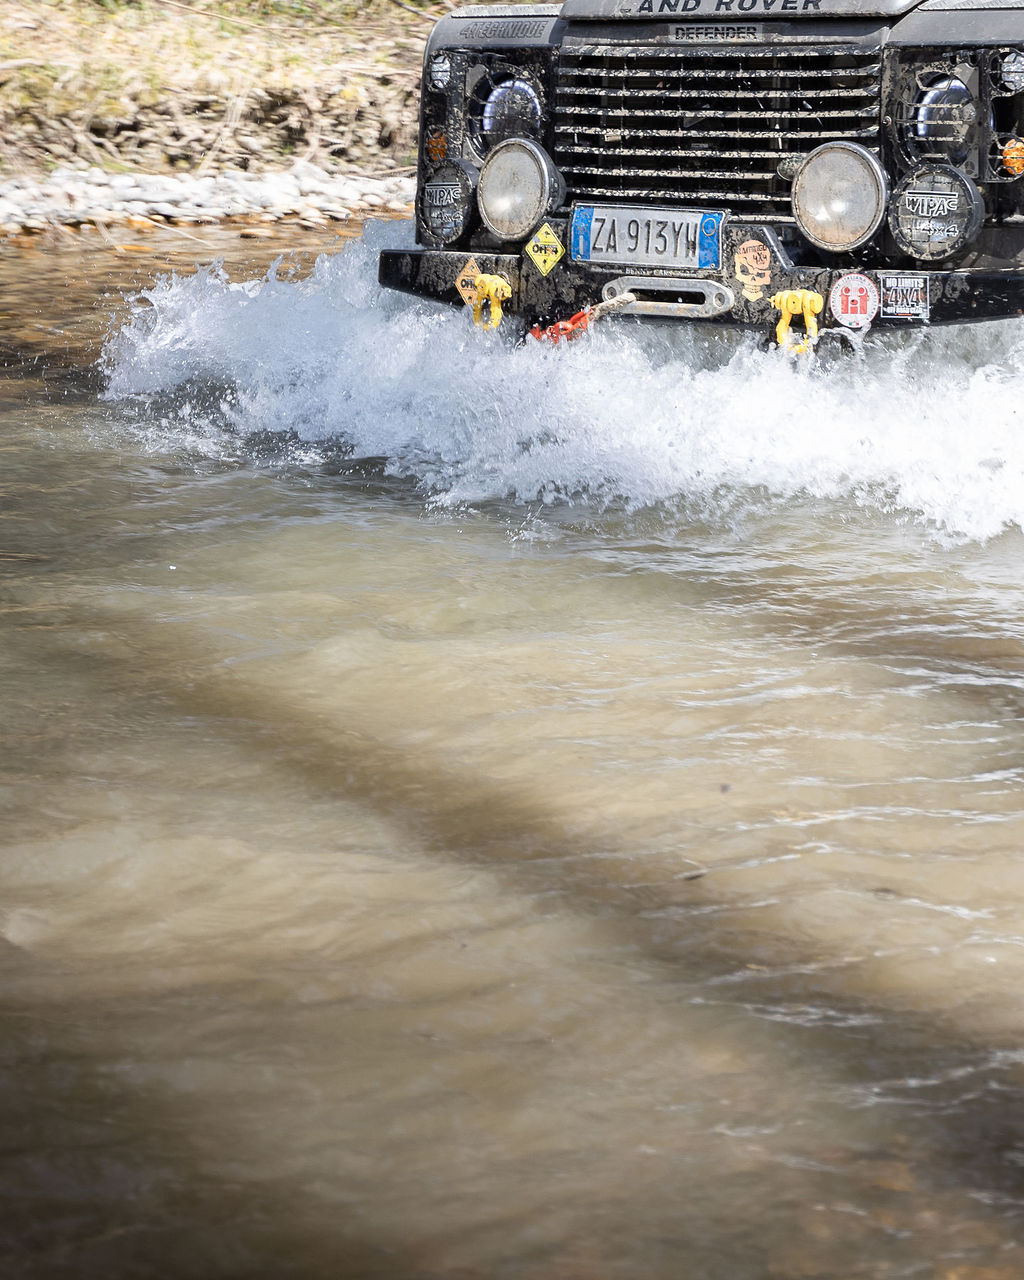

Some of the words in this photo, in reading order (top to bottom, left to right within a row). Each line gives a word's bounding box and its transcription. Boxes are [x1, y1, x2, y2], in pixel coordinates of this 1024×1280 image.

[675, 27, 758, 40] DEFENDER
[906, 196, 959, 217] WIPAC
[592, 218, 618, 253] ZA
[898, 278, 925, 289] LIMITS
